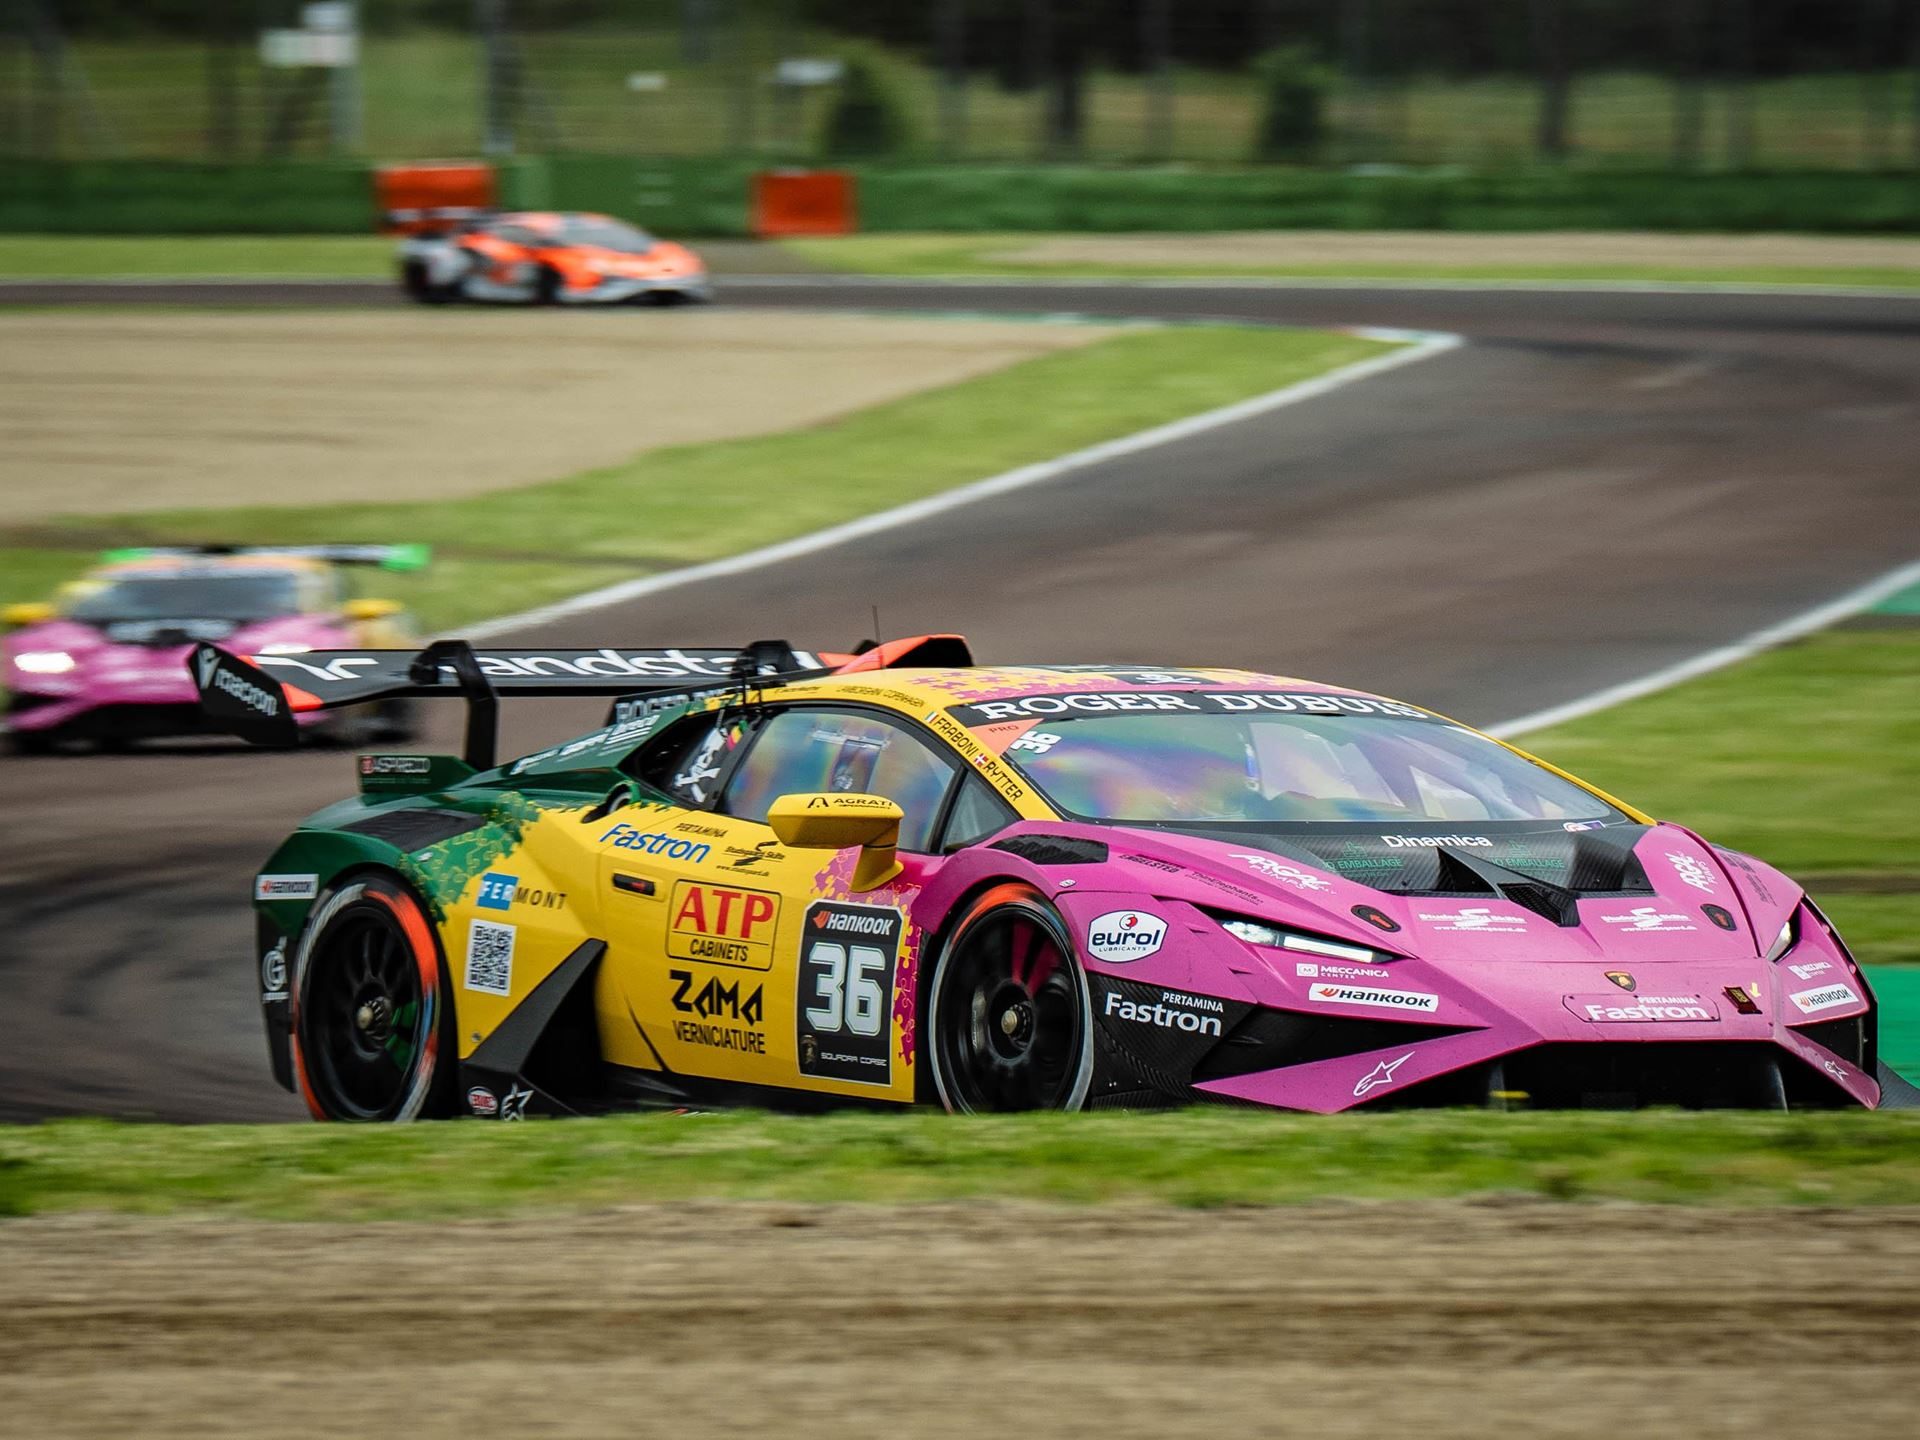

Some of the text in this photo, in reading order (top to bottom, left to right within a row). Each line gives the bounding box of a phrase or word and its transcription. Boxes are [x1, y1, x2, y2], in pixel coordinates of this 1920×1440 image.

[971, 692, 1429, 719] ROGER DUBUIS
[936, 717, 979, 757] FRABONI
[988, 724, 1020, 733] PRO
[1010, 730, 1062, 754] 36
[983, 761, 1024, 801] RYTTER
[833, 798, 893, 807] AGRATI
[600, 823, 711, 863] Fastron
[1381, 835, 1493, 848] Dinamica
[1337, 858, 1403, 869] EMBALLAGE
[1505, 859, 1565, 868] EMBALLAGE
[674, 886, 774, 939] ATP
[1092, 930, 1160, 946] eurol
[690, 939, 749, 962] CABINETS
[1321, 965, 1389, 978] MECCANICA
[670, 969, 763, 1027] ZAMA
[805, 942, 886, 1036] 36
[1162, 992, 1224, 1013] PERTAMINA
[1637, 996, 1698, 1005] PERTAMINA
[1105, 992, 1222, 1036] Fastron
[1584, 1005, 1710, 1020] Fastron
[672, 1020, 766, 1055] VERNICIATURE
[860, 1056, 887, 1066] CORSE
